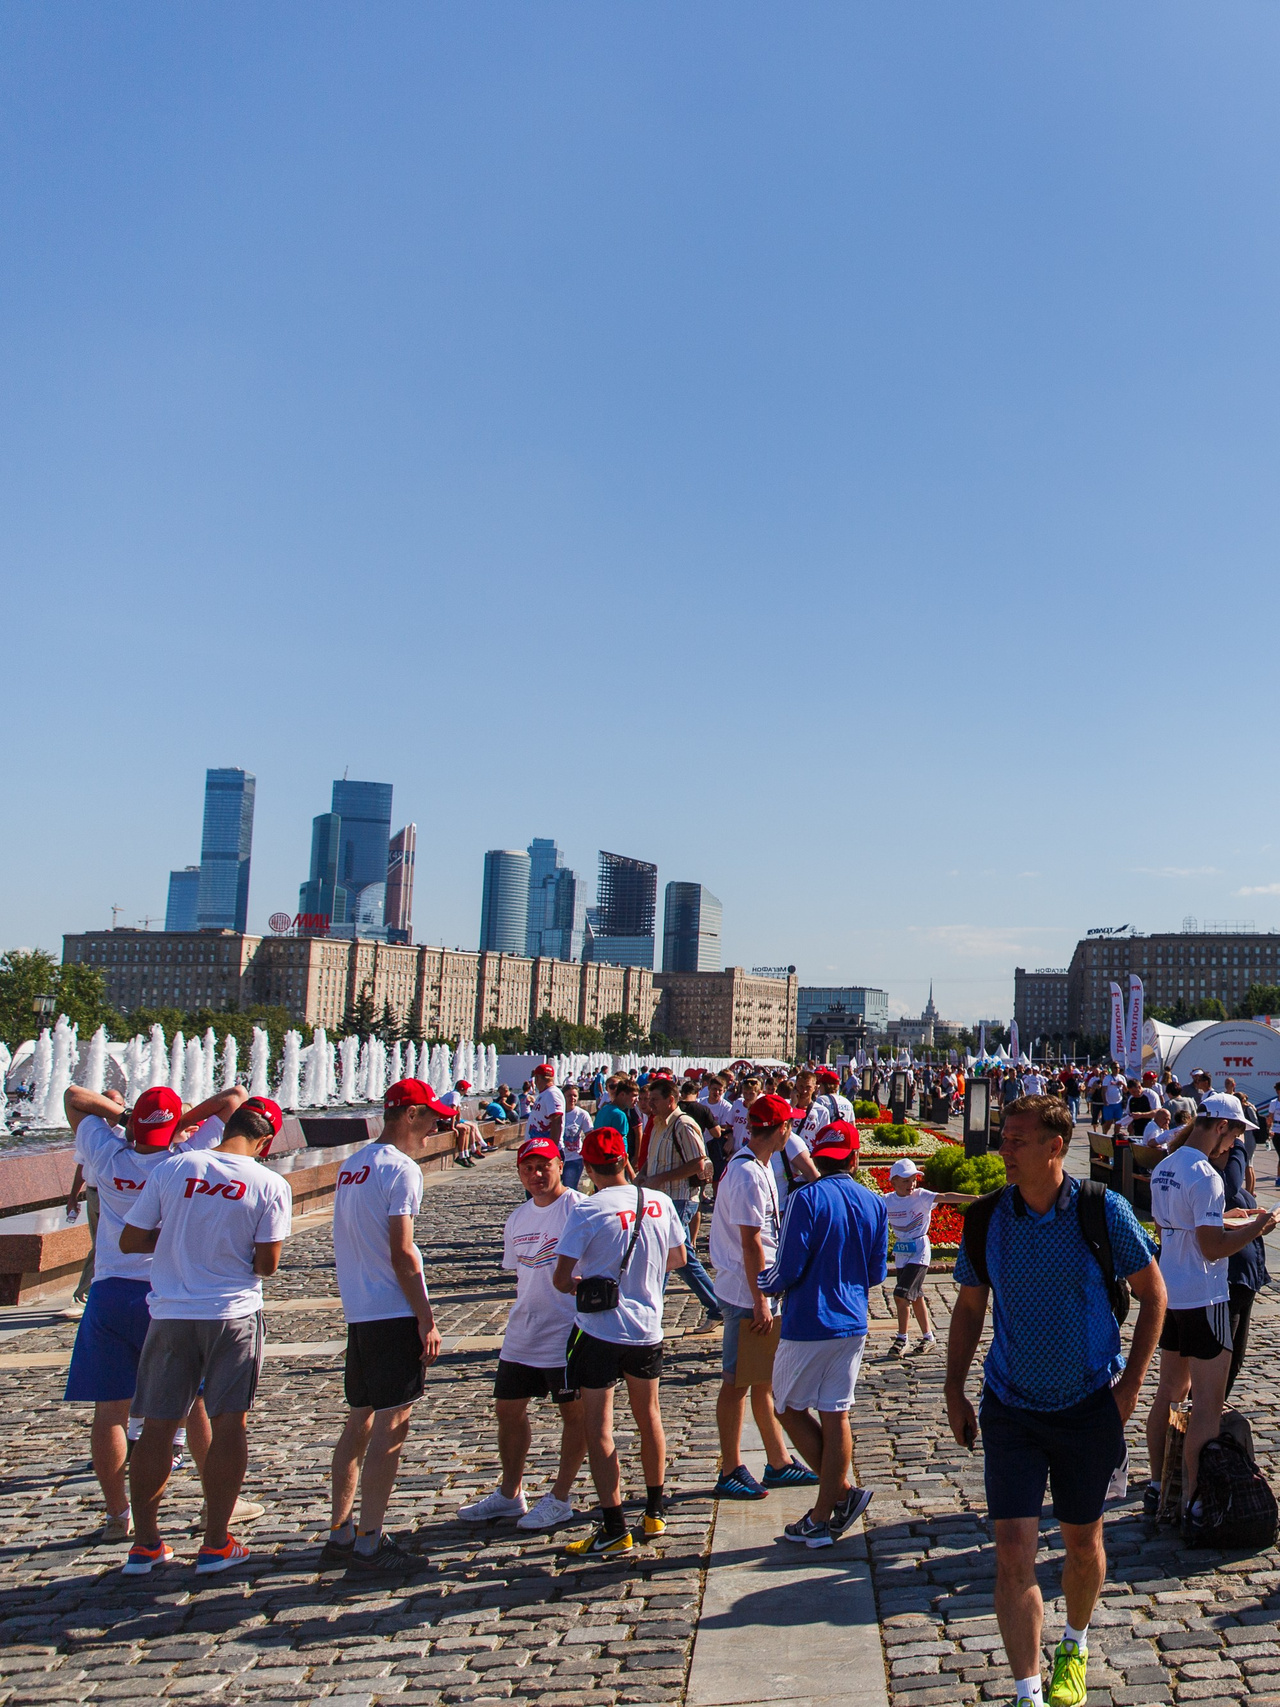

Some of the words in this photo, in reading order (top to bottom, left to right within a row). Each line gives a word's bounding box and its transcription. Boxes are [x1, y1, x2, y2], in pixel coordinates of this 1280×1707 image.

[1115, 1004, 1124, 1053] ТРИАТЛОН
[1130, 998, 1140, 1053] ТРИАТЛОН
[1223, 1056, 1254, 1067] ТТК
[184, 1177, 247, 1201] РЖД
[337, 1165, 371, 1190] РЖД
